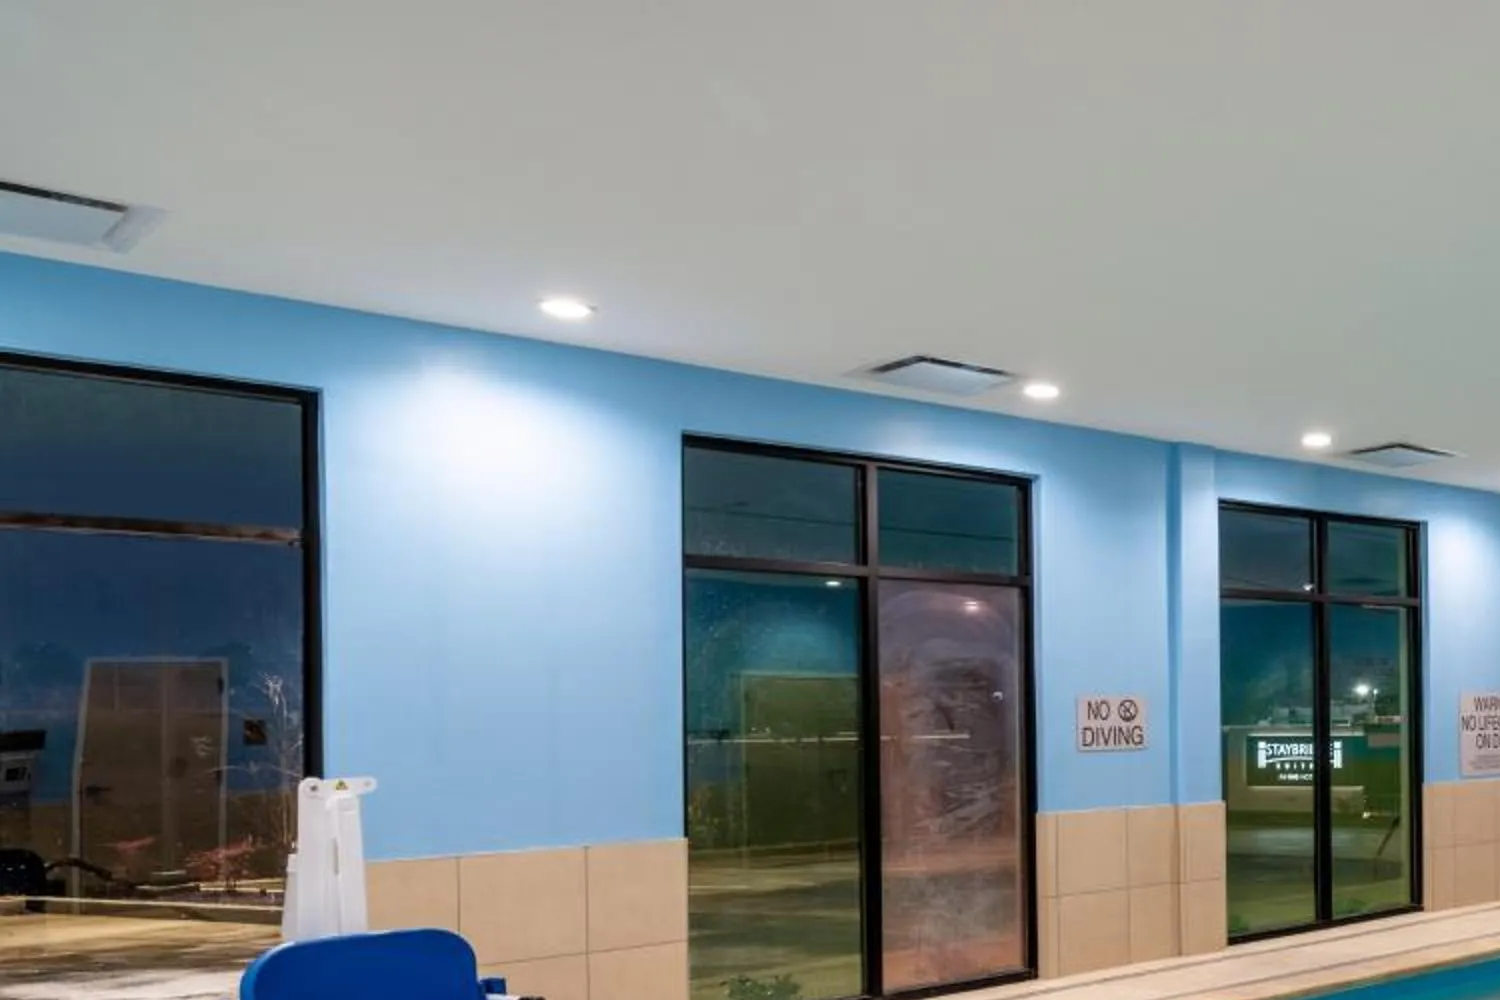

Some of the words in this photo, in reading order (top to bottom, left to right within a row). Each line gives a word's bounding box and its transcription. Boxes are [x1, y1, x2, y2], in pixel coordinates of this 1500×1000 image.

[1088, 700, 1111, 720] NO
[1461, 714, 1477, 732] NO
[1082, 725, 1145, 747] DIVING
[1476, 732, 1491, 749] ON
